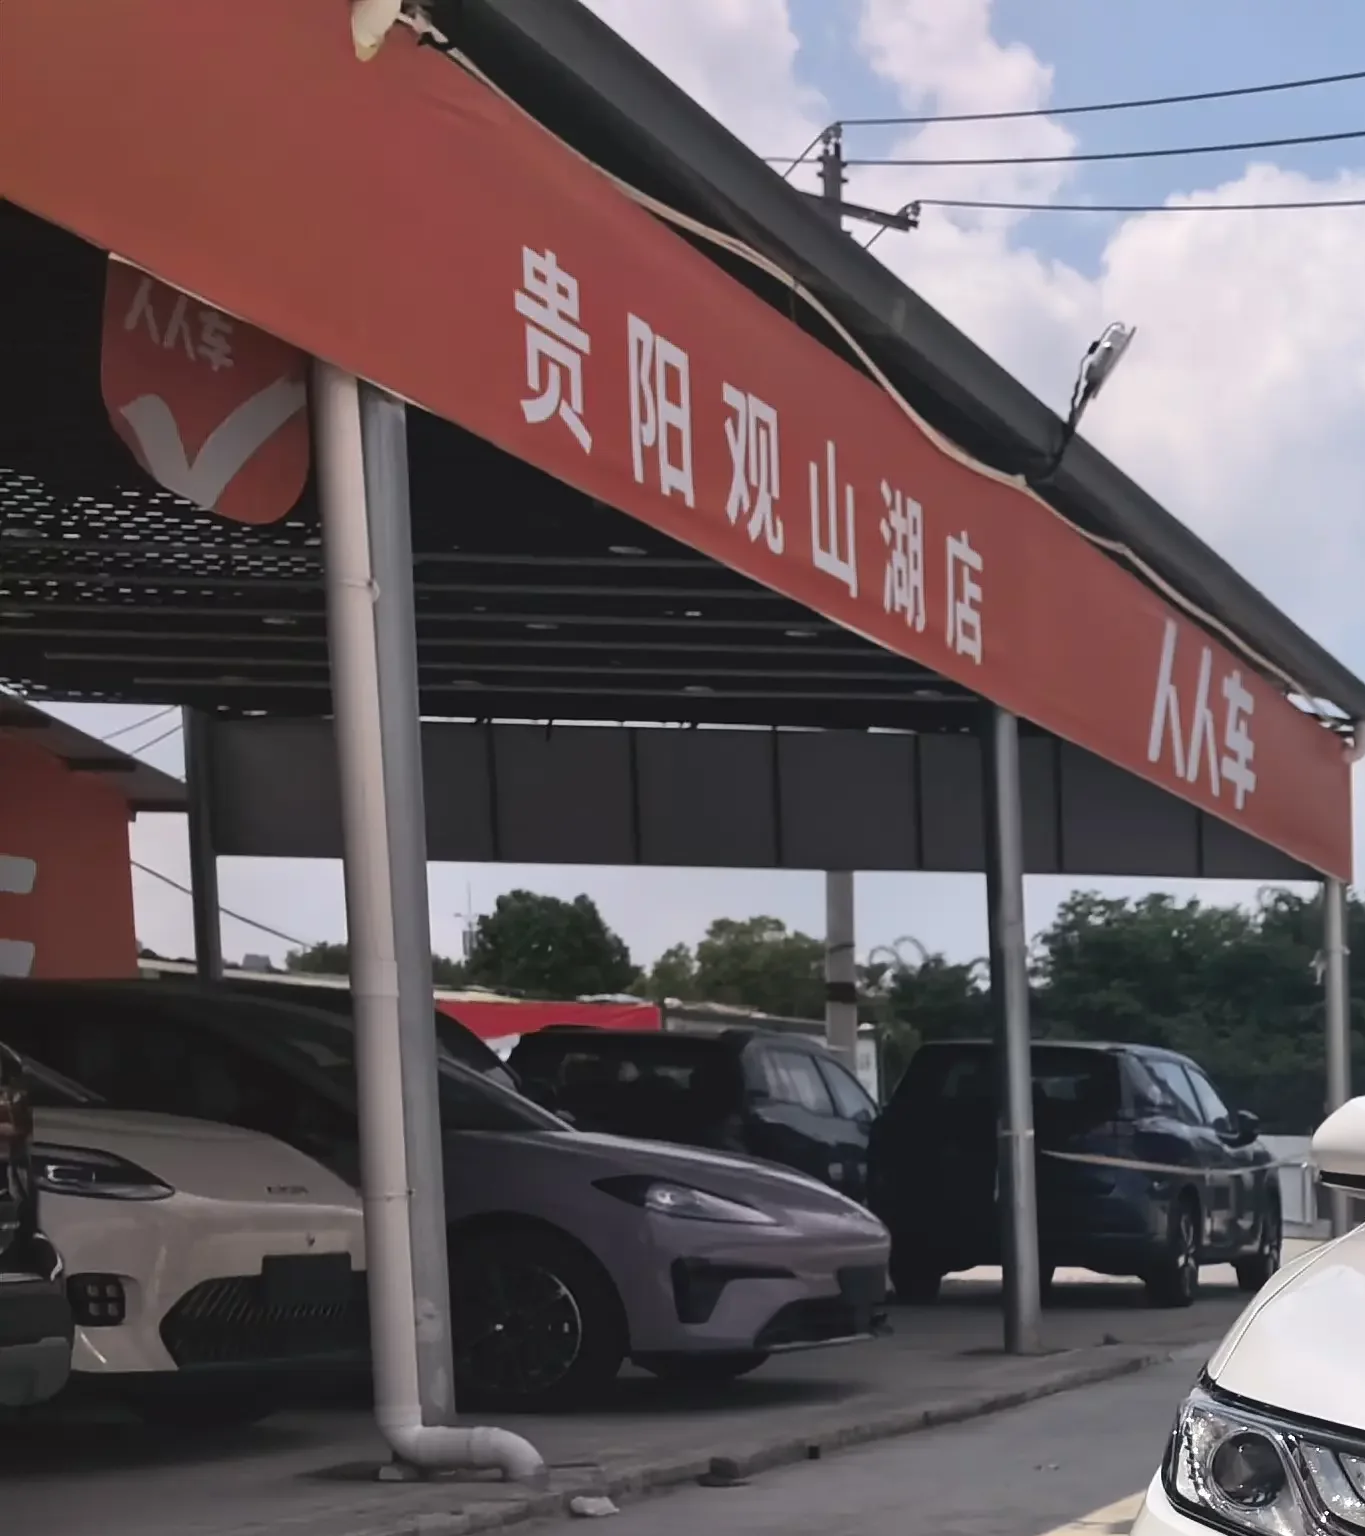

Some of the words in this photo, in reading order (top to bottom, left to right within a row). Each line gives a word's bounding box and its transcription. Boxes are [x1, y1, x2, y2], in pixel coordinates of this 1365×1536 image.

[124, 277, 235, 373] 人人车
[514, 246, 984, 666] 贵阳观山湖店
[1148, 619, 1257, 811] 人人车
